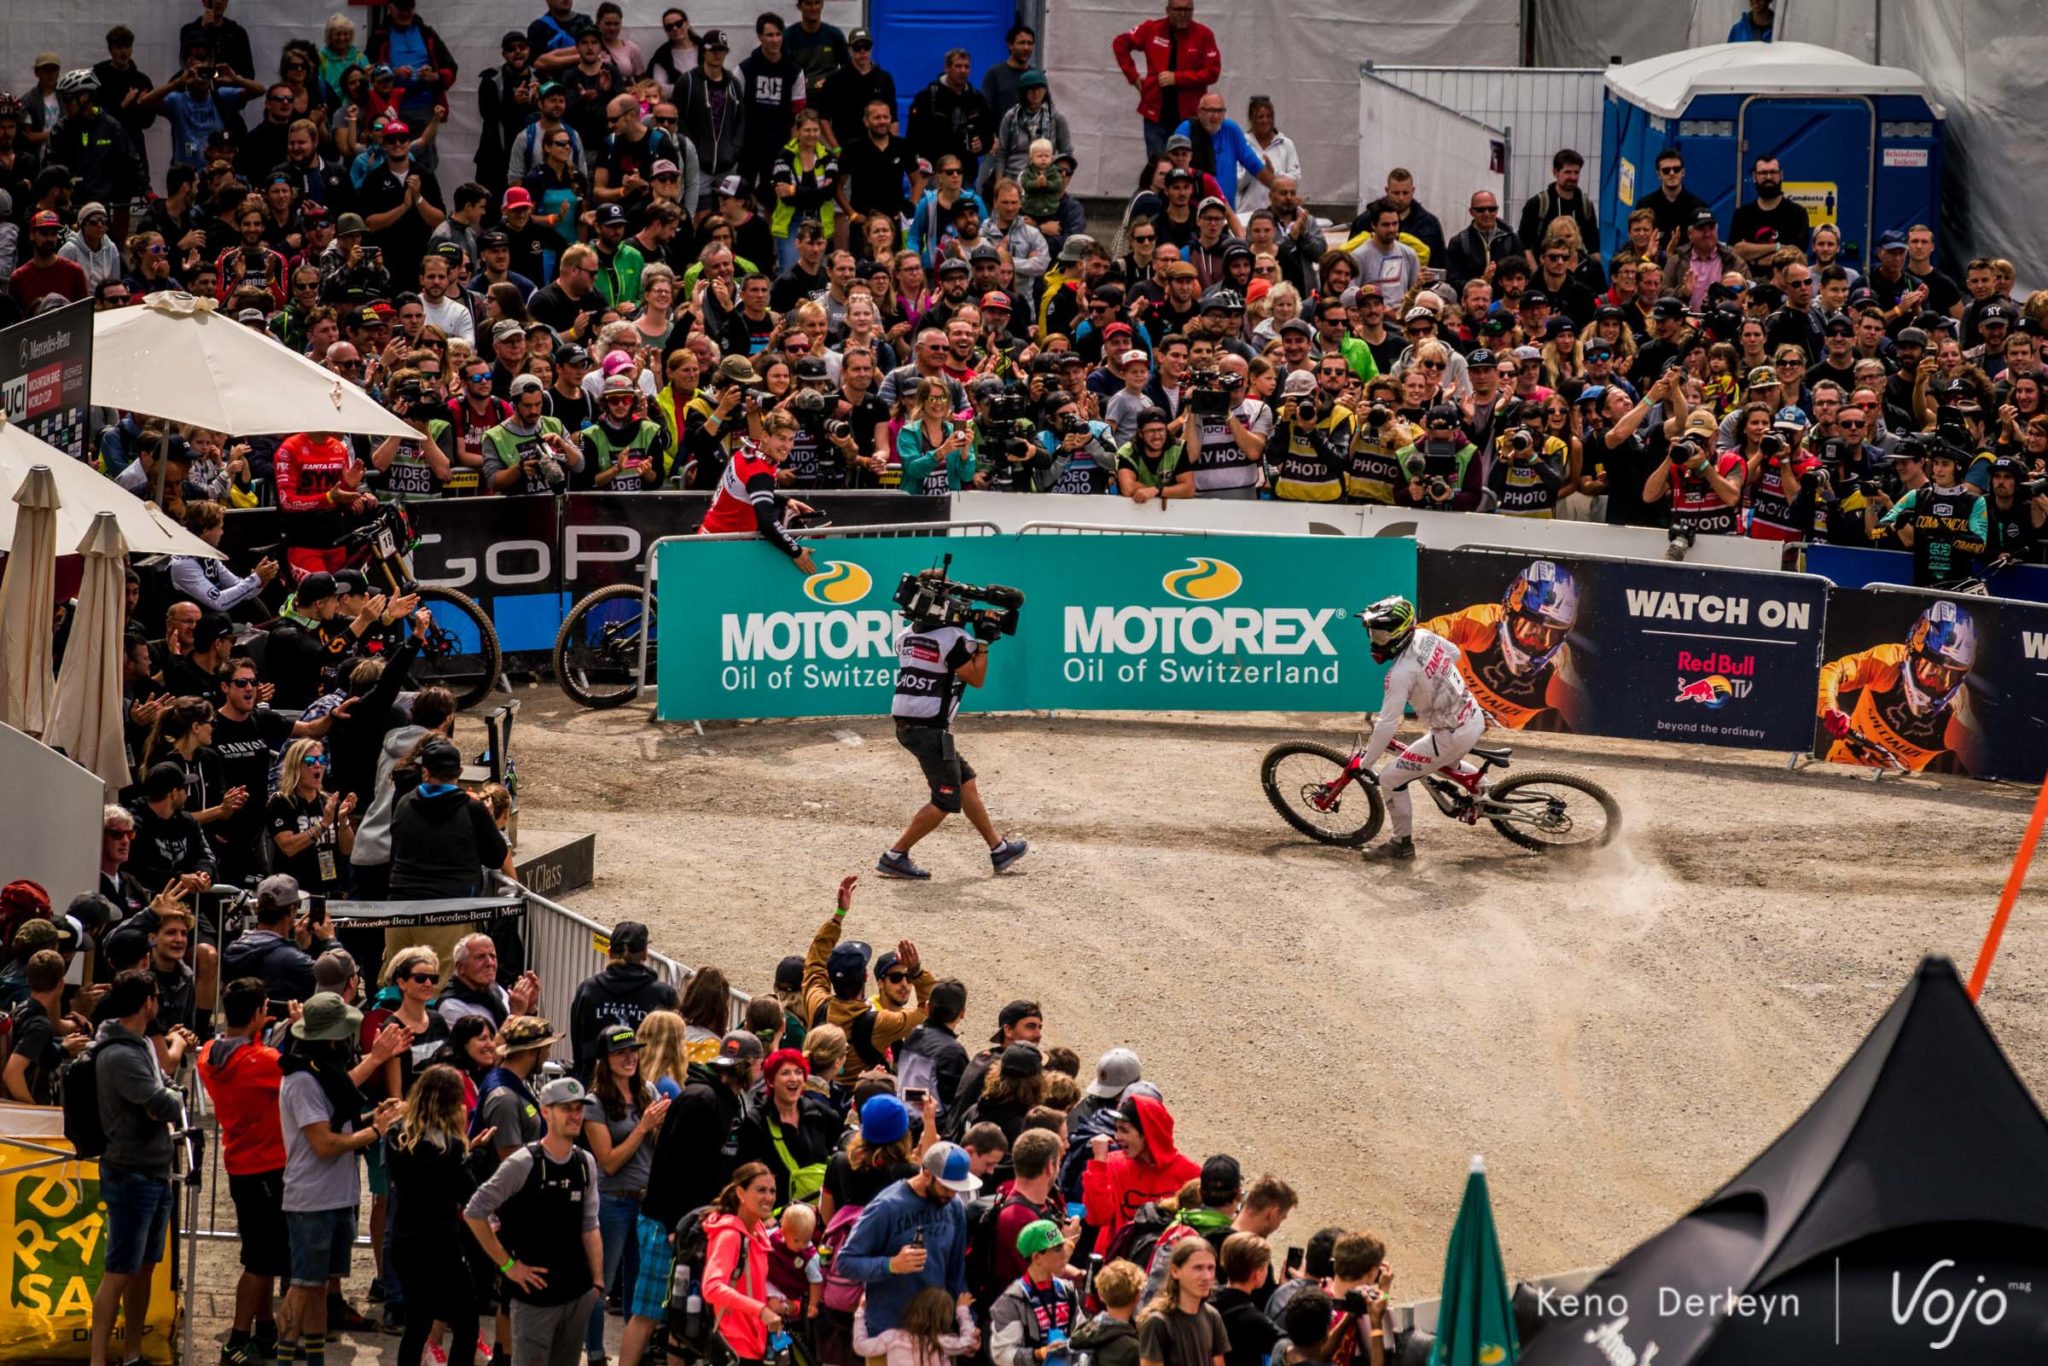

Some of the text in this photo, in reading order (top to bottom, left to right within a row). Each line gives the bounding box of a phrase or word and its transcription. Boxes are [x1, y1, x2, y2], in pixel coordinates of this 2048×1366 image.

[1216, 448, 1246, 463] HOS
[391, 466, 431, 480] VIDEO
[1353, 458, 1399, 479] PHOTO
[389, 478, 431, 492] RADIO
[1502, 490, 1548, 505] PHOTO
[1625, 589, 1811, 630] WATCH ON
[721, 609, 902, 662] MOTOR
[1063, 658, 1339, 684] Oil of Switzerland
[1677, 650, 1756, 676] Red Bull
[722, 663, 902, 692] Oil of Switzer
[1730, 678, 1753, 699] TV
[1656, 720, 1766, 739] beyond the ordinary
[535, 863, 562, 894] Class
[347, 917, 415, 929] Mercedes-Benz
[424, 910, 493, 924] Mercedes-Benz
[612, 1031, 635, 1042] SCOTT
